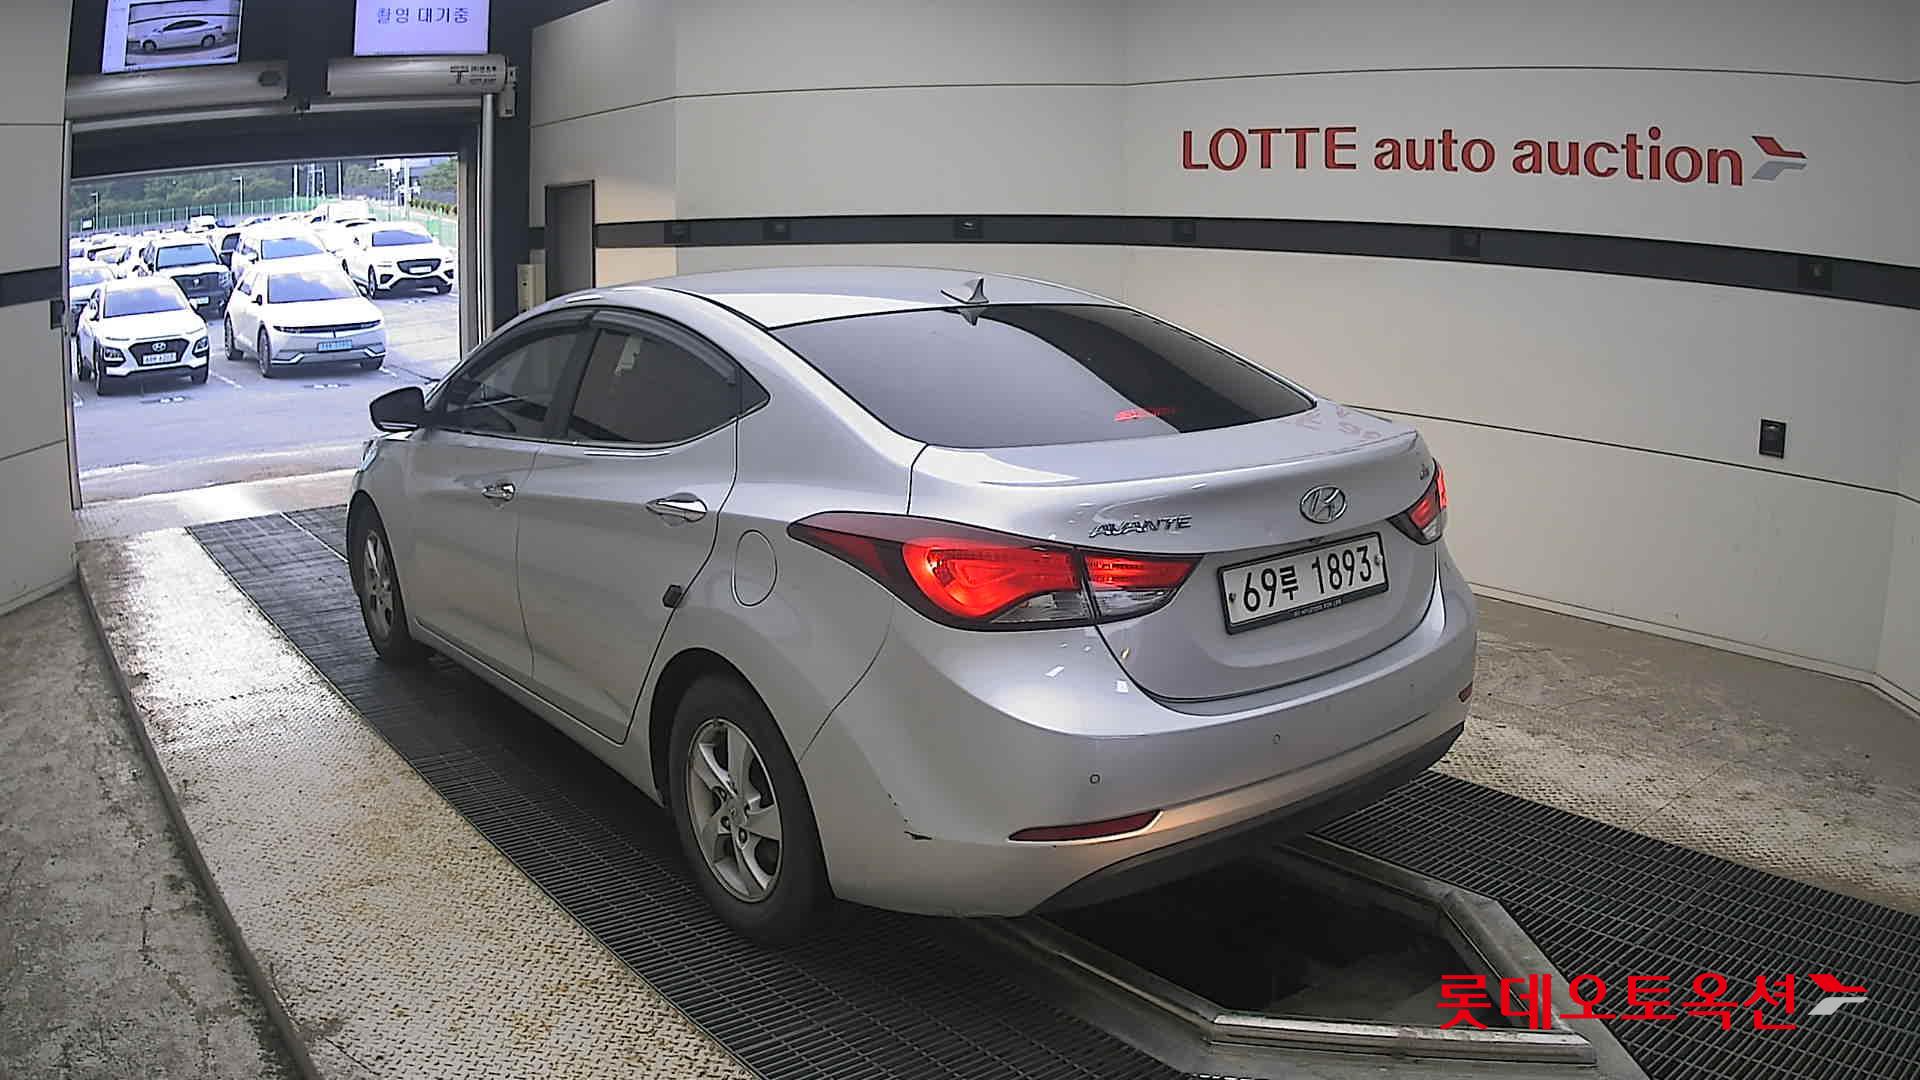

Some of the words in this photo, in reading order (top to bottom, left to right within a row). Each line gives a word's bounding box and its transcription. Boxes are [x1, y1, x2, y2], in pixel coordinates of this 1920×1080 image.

[417, 7, 469, 24] 대기중
[1183, 127, 1357, 170] LOTTE
[1374, 128, 1496, 173] auto
[1512, 126, 1744, 187] auction
[1088, 516, 1193, 539] AVANTE
[1243, 564, 1300, 612] 69루
[1311, 545, 1373, 594] 1893
